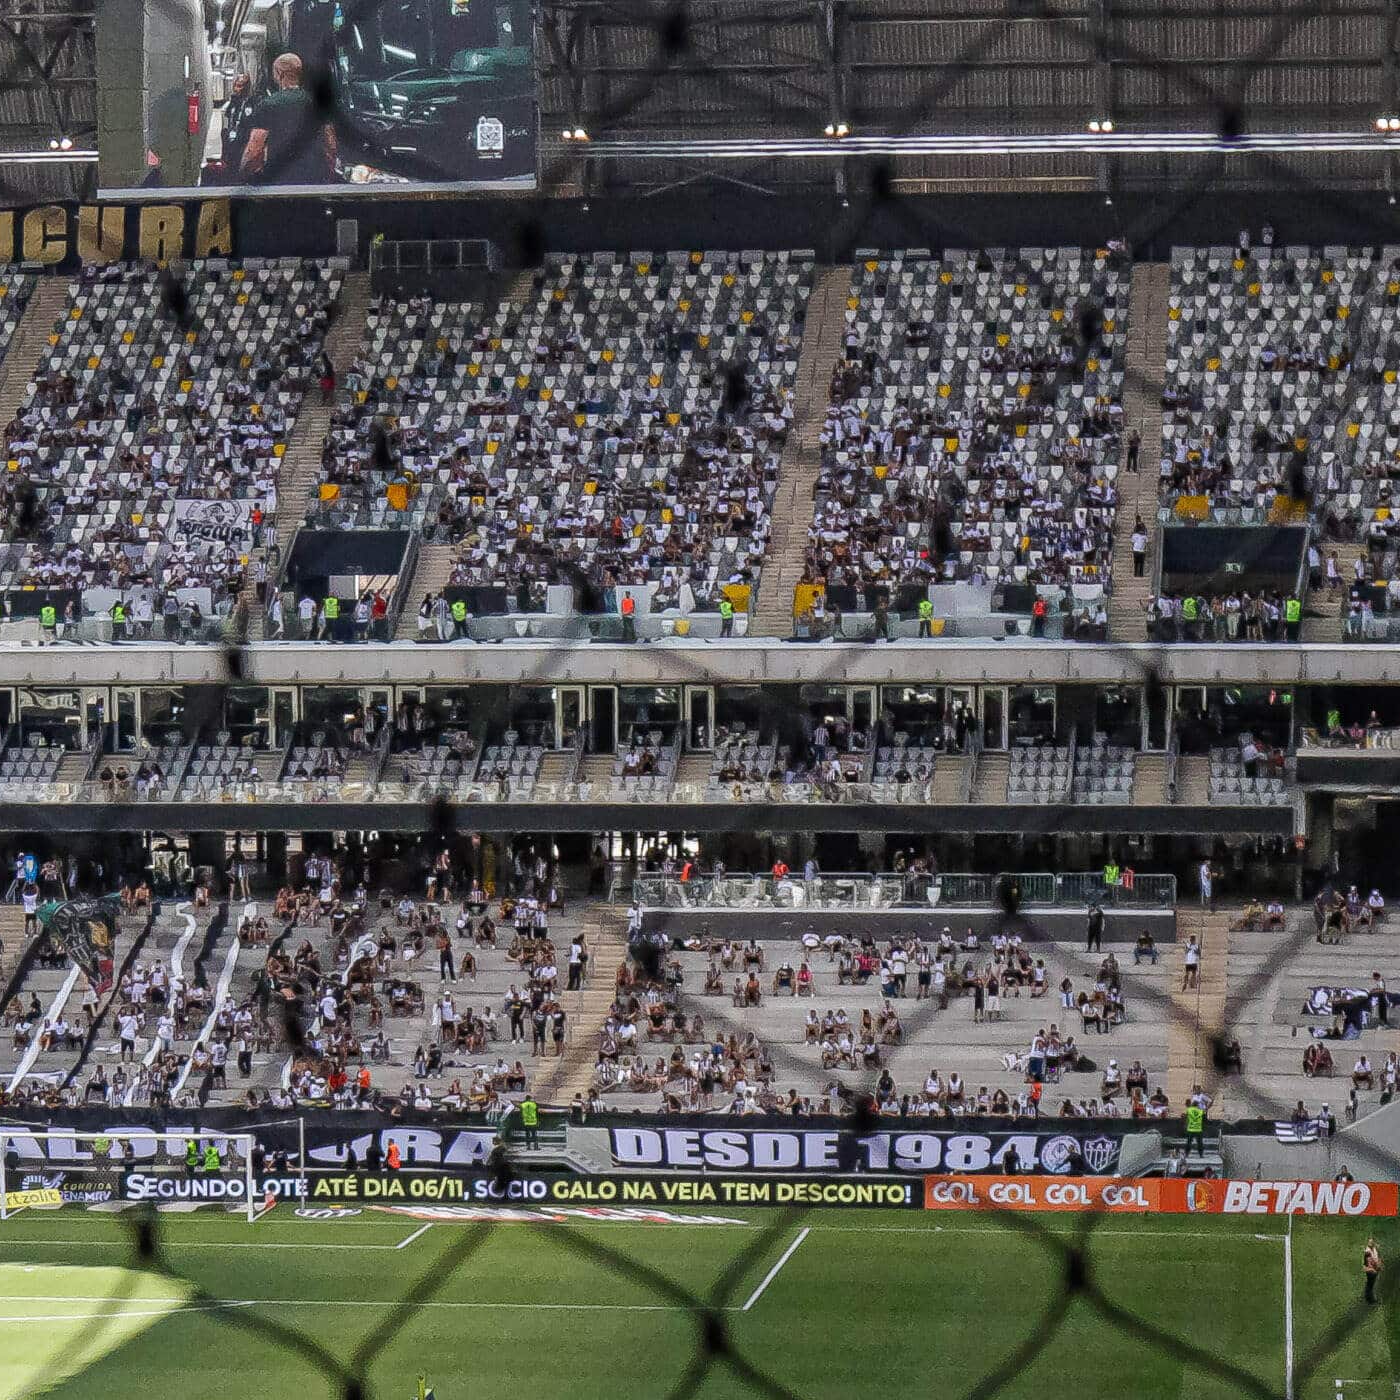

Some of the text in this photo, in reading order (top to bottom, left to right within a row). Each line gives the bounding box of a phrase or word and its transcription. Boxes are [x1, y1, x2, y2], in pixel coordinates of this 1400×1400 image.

[613, 1128, 839, 1168] DESDE
[857, 1133, 1040, 1171] 1984
[126, 1173, 245, 1199] SEGUNDO
[251, 1178, 309, 1197] LOTE
[314, 1175, 358, 1197] ATÉ
[363, 1178, 405, 1197] DIA
[410, 1178, 469, 1200] 06/11,
[552, 1179, 617, 1200] GALO
[623, 1182, 657, 1200] NA
[661, 1182, 718, 1201] VEIA
[720, 1182, 770, 1202] TEM
[776, 1183, 912, 1204] DESCONTO!
[932, 1180, 1149, 1207] GOL GOL GOL GOL
[1223, 1180, 1371, 1215] BETANO
